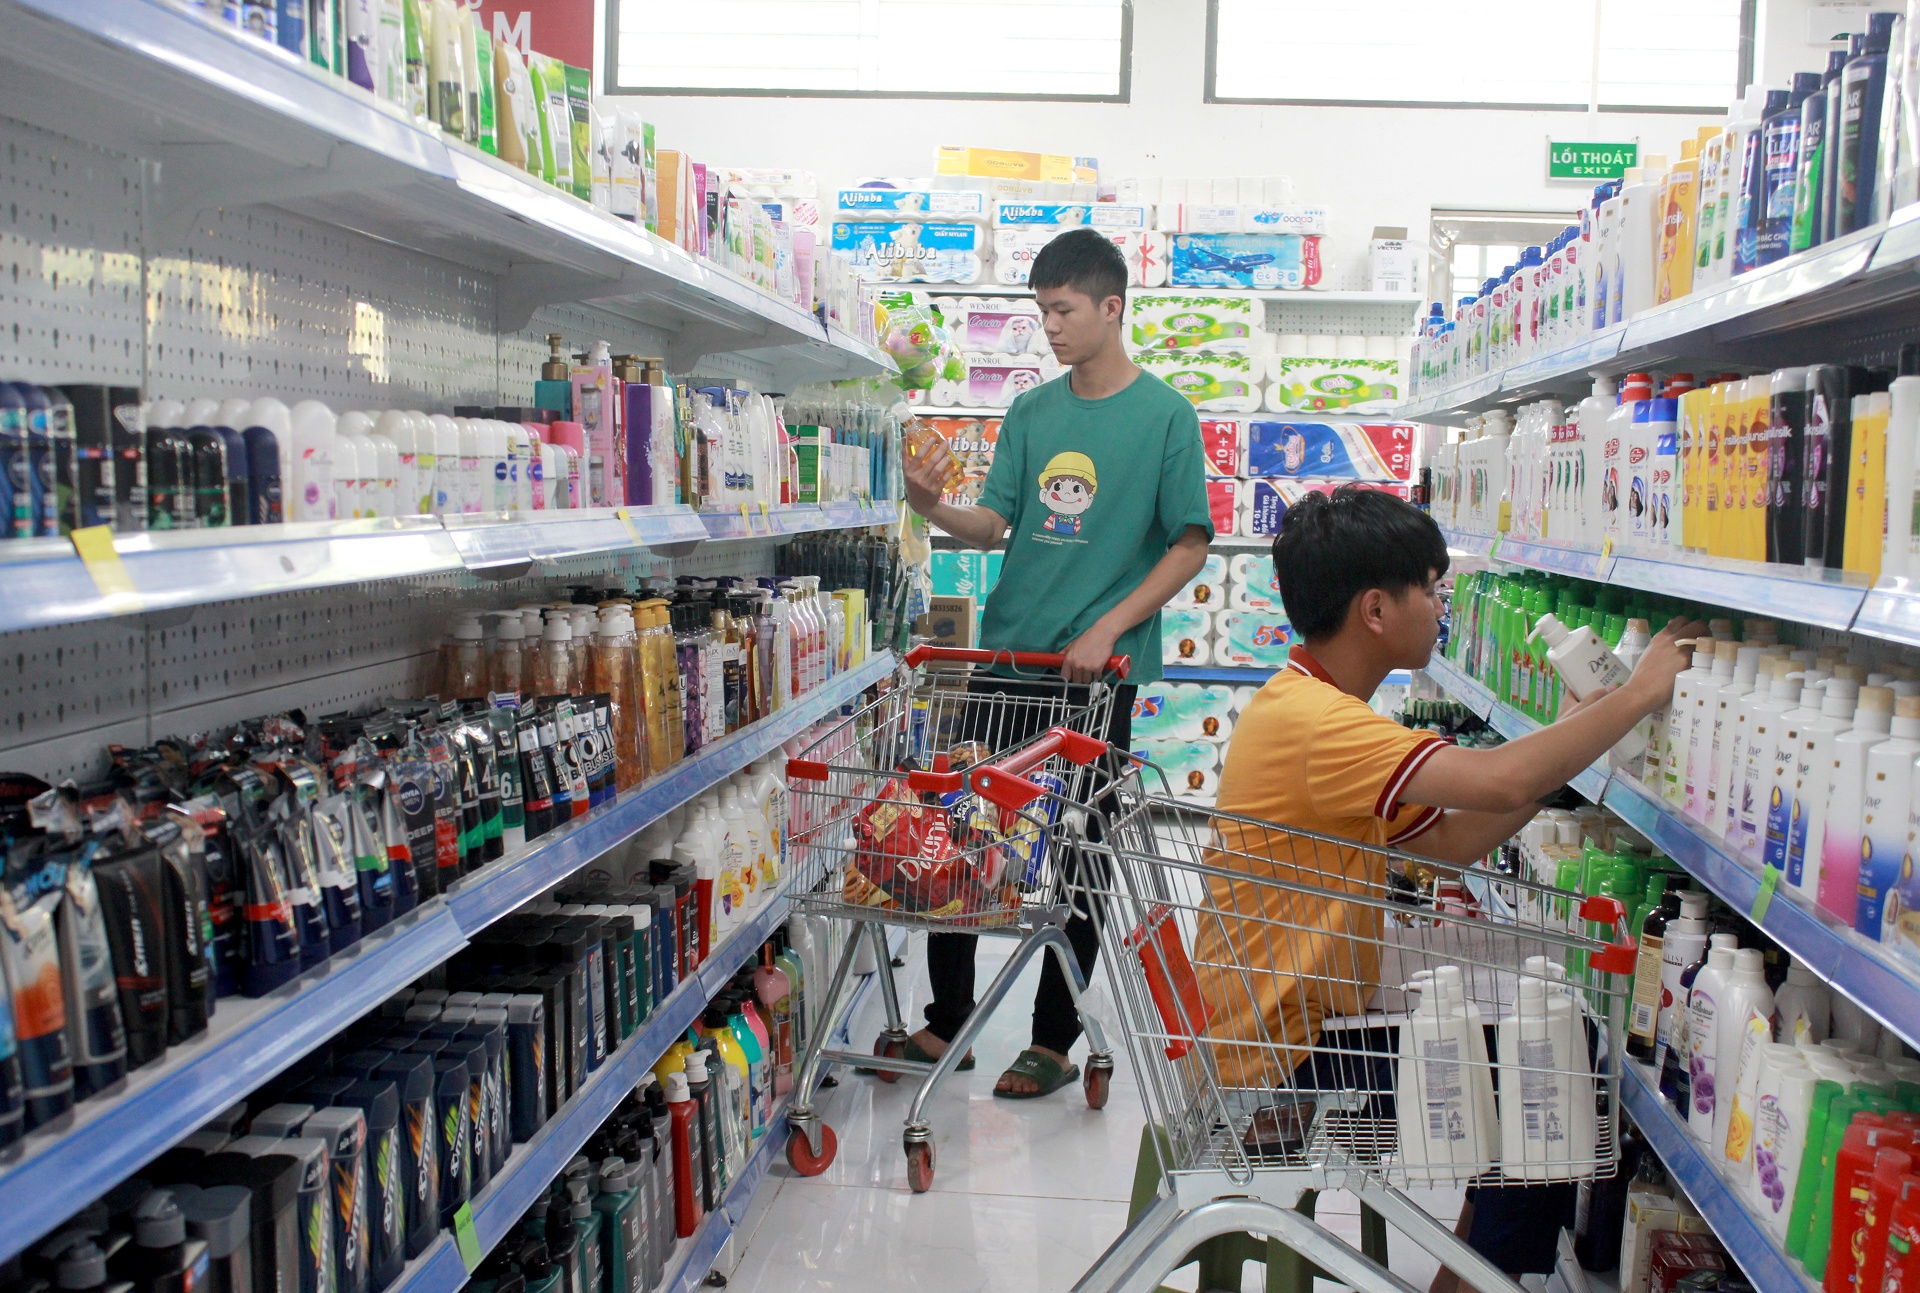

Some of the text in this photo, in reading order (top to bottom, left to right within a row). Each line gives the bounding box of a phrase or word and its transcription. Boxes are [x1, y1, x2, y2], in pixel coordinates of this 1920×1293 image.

[1553, 147, 1634, 165] LỐI THOÁT
[1573, 166, 1611, 175] EXIT
[840, 192, 883, 208] Alibaba
[1002, 206, 1044, 221] Alibaba
[864, 241, 937, 267] Alibaba
[969, 302, 1002, 311] WENROU
[970, 356, 1003, 366] WENROU
[1216, 422, 1232, 435] 2
[947, 436, 996, 452] libaba
[1391, 453, 1403, 471] 10
[1397, 427, 1410, 441] 2
[1216, 451, 1228, 466] 10
[1253, 509, 1261, 520] 10
[1587, 650, 1610, 674] Dove
[401, 788, 420, 799] NIVEA
[435, 806, 453, 818] EEP
[407, 823, 434, 841] DEEP
